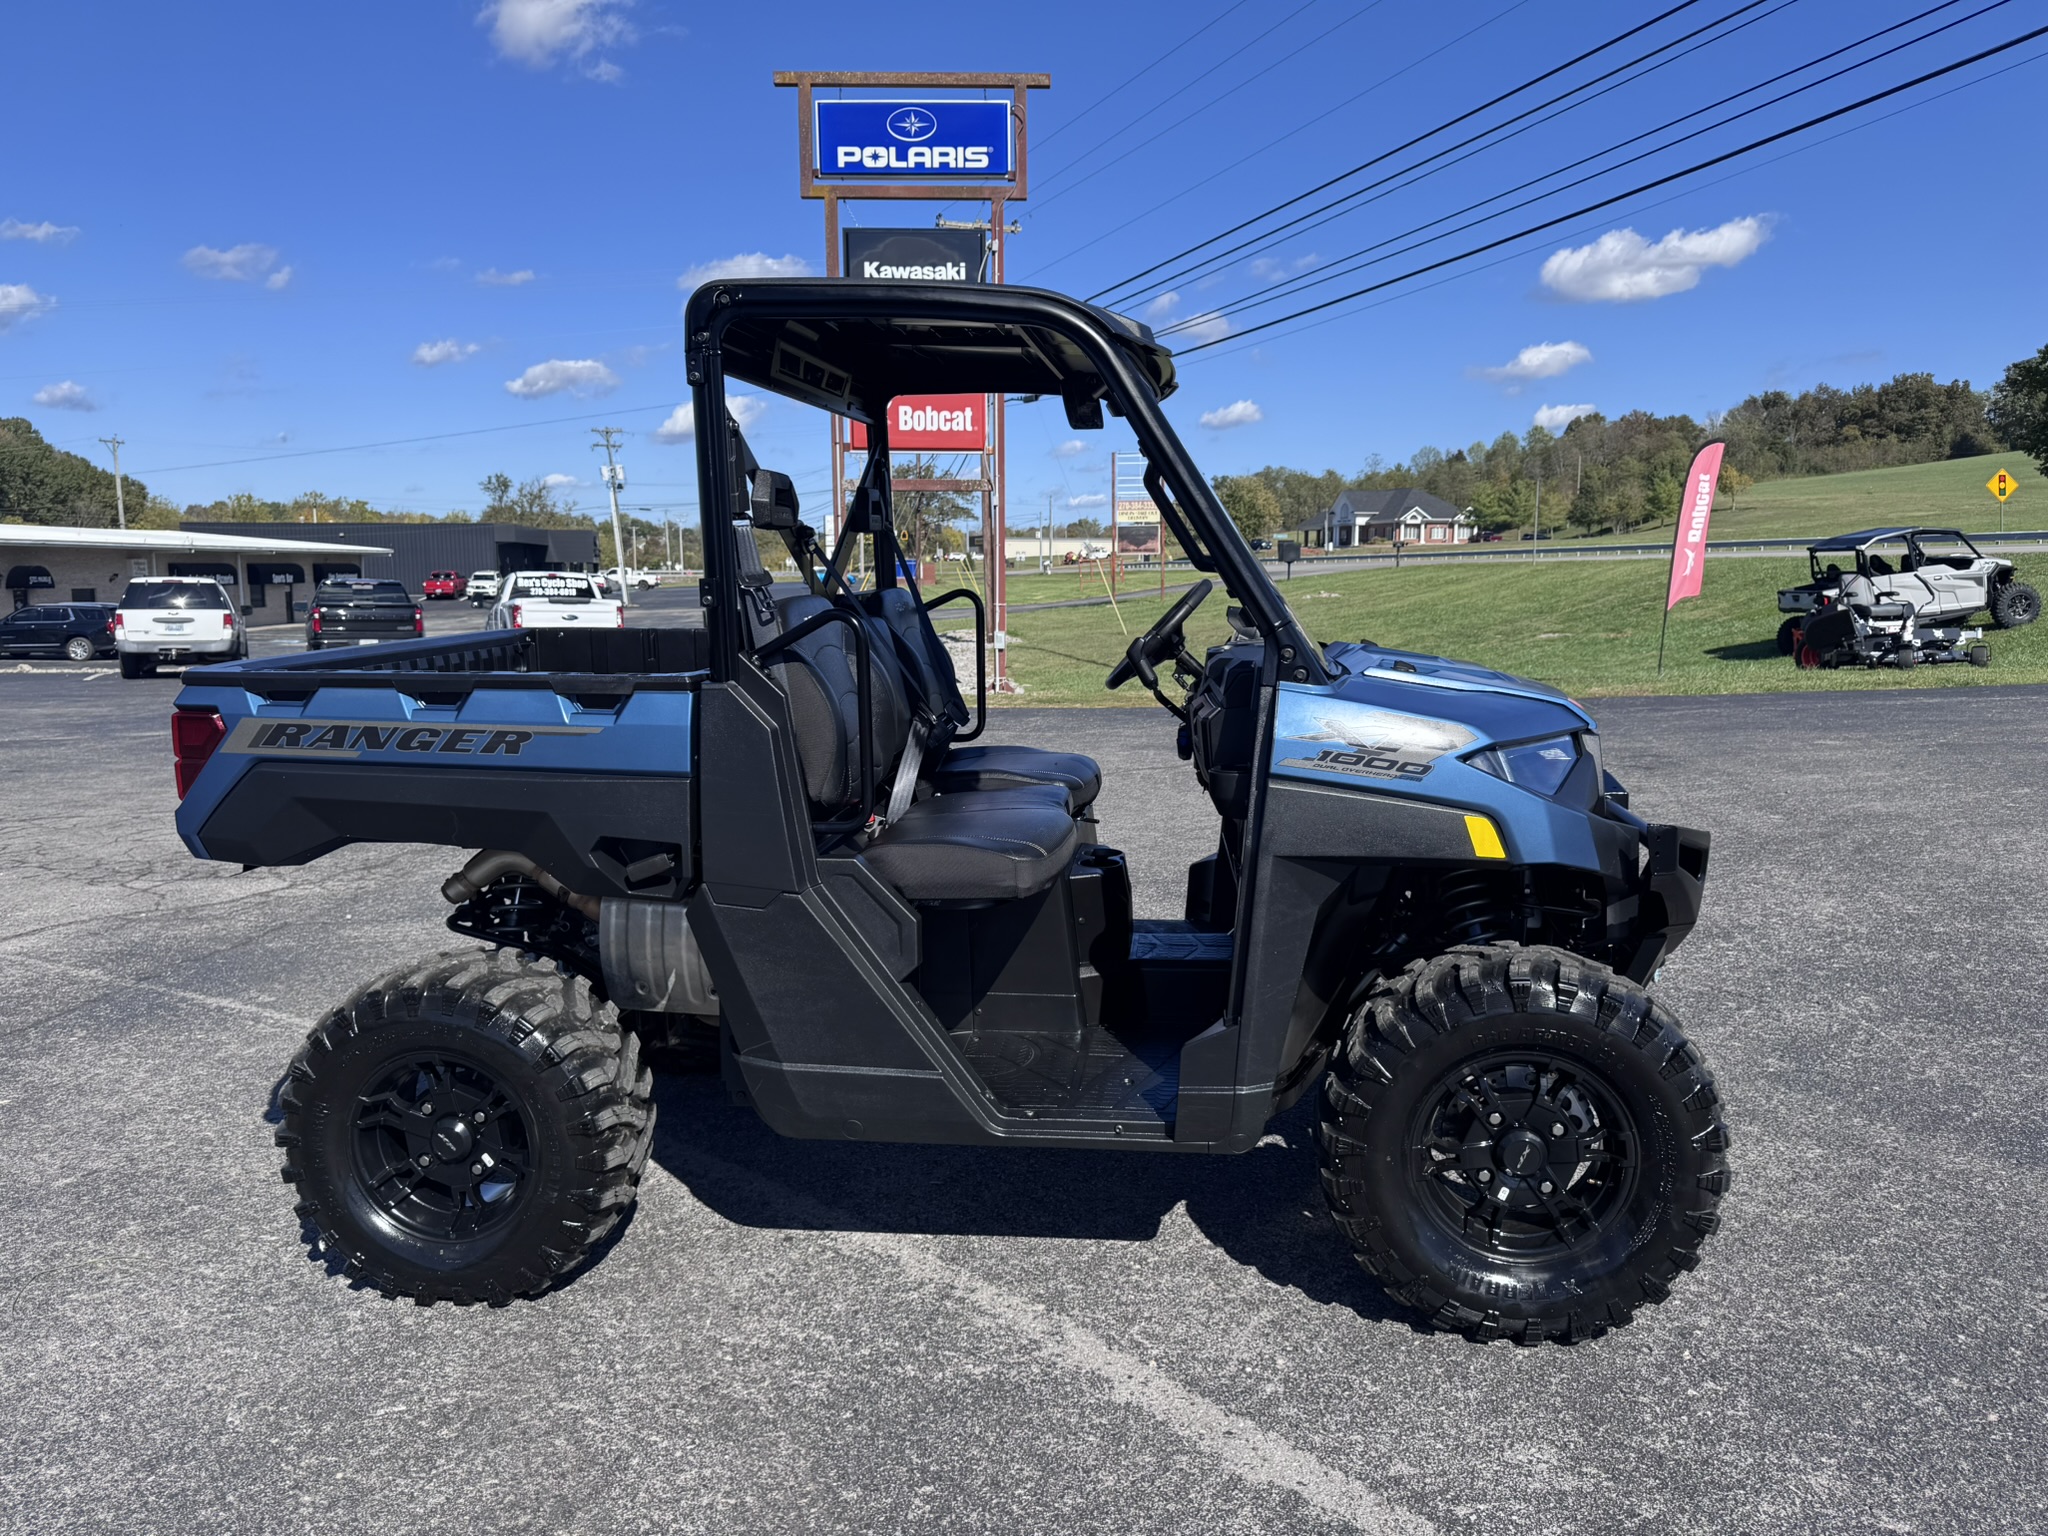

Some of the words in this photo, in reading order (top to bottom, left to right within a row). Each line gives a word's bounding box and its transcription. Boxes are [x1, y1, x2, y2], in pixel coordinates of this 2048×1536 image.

[837, 146, 989, 168] POLARIS
[863, 261, 966, 280] Kawasaki
[898, 405, 973, 432] Bobcat
[1687, 473, 1711, 543] Bobcat
[517, 577, 541, 587] Rex's
[541, 577, 565, 588] Cycle
[565, 578, 588, 589] Shop
[259, 723, 534, 756] RANGER
[1312, 763, 1339, 772] DUAL
[1341, 767, 1398, 779] OVERHEAD
[1315, 750, 1434, 776] 1000
